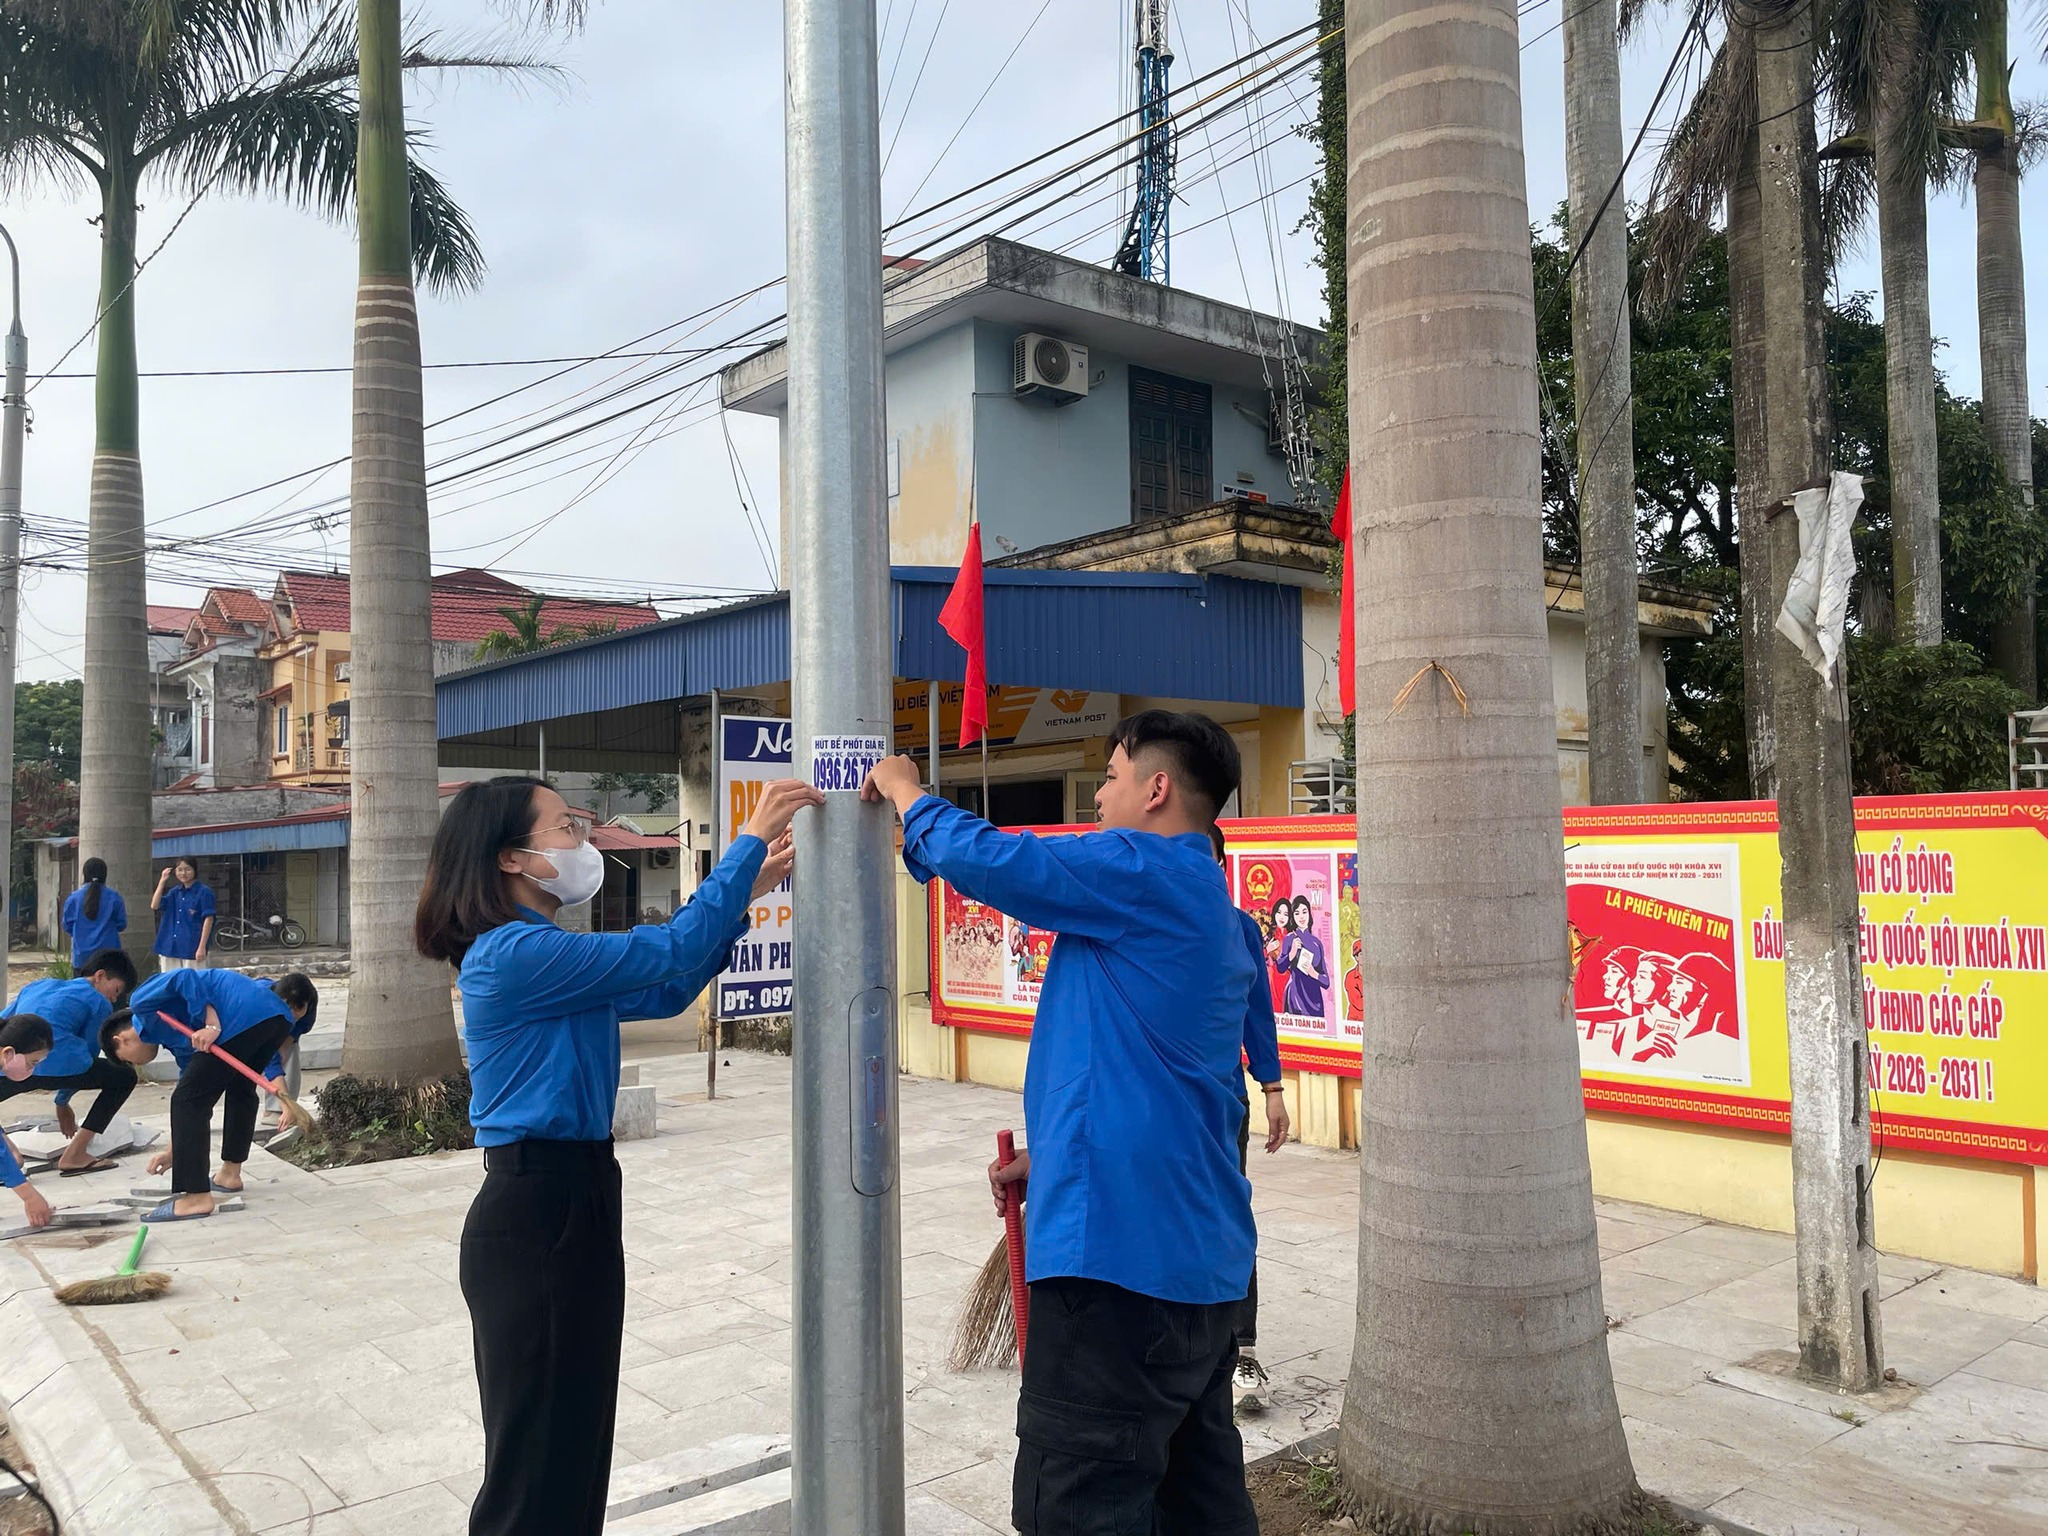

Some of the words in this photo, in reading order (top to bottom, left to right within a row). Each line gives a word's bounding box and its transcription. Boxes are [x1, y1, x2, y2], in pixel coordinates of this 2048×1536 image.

[1045, 716, 1081, 727] VIETNAM
[1084, 713, 1107, 723] POST
[815, 738, 828, 750] HÚT
[830, 736, 841, 750] BỂ
[843, 737, 863, 750] PHỐT
[865, 738, 876, 750] GIÁ
[1881, 837, 1902, 893] CỔ
[1906, 844, 1953, 903] ĐỘNG
[1706, 918, 1729, 941] TIN
[1753, 908, 1783, 960] BẦU
[1882, 910, 1926, 969] QUỐC
[1931, 917, 1959, 976] HỘI
[1965, 918, 2012, 969] KHOÁ
[2016, 927, 2047, 971] XVI
[724, 989, 755, 1012] ĐT:
[1879, 991, 1925, 1033] HĐND
[1929, 986, 1963, 1036] CÁC
[1968, 982, 2002, 1039] CẤP
[1281, 1015, 1293, 1027] CỦA
[1887, 1053, 1926, 1094] 2026
[1941, 1058, 1980, 1099] 2031
